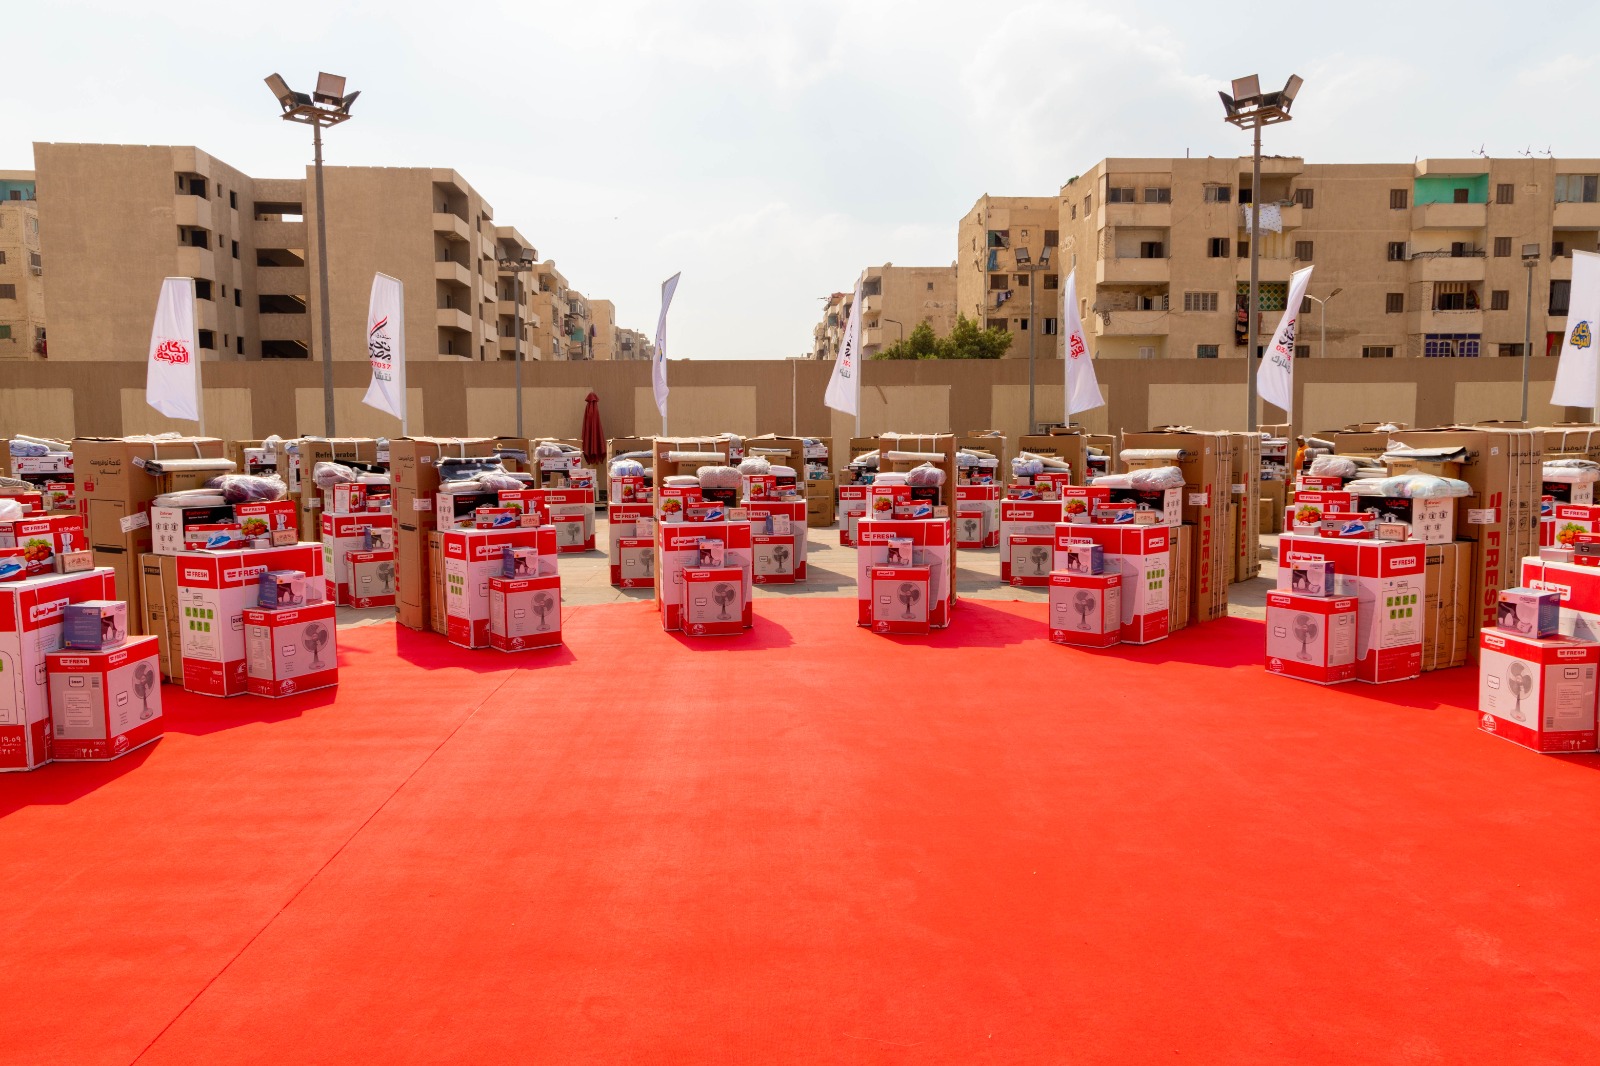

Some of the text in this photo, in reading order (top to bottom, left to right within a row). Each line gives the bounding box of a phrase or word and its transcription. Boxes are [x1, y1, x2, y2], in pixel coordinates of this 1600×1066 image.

[160, 341, 186, 353] دكان
[157, 350, 189, 364] الفرحة
[315, 451, 356, 459] Refrierator
[478, 545, 501, 554] فريش
[1200, 515, 1211, 594] FRESH
[238, 568, 265, 577] FRESH
[1483, 531, 1500, 627] FRESH
[32, 603, 58, 618] فريش
